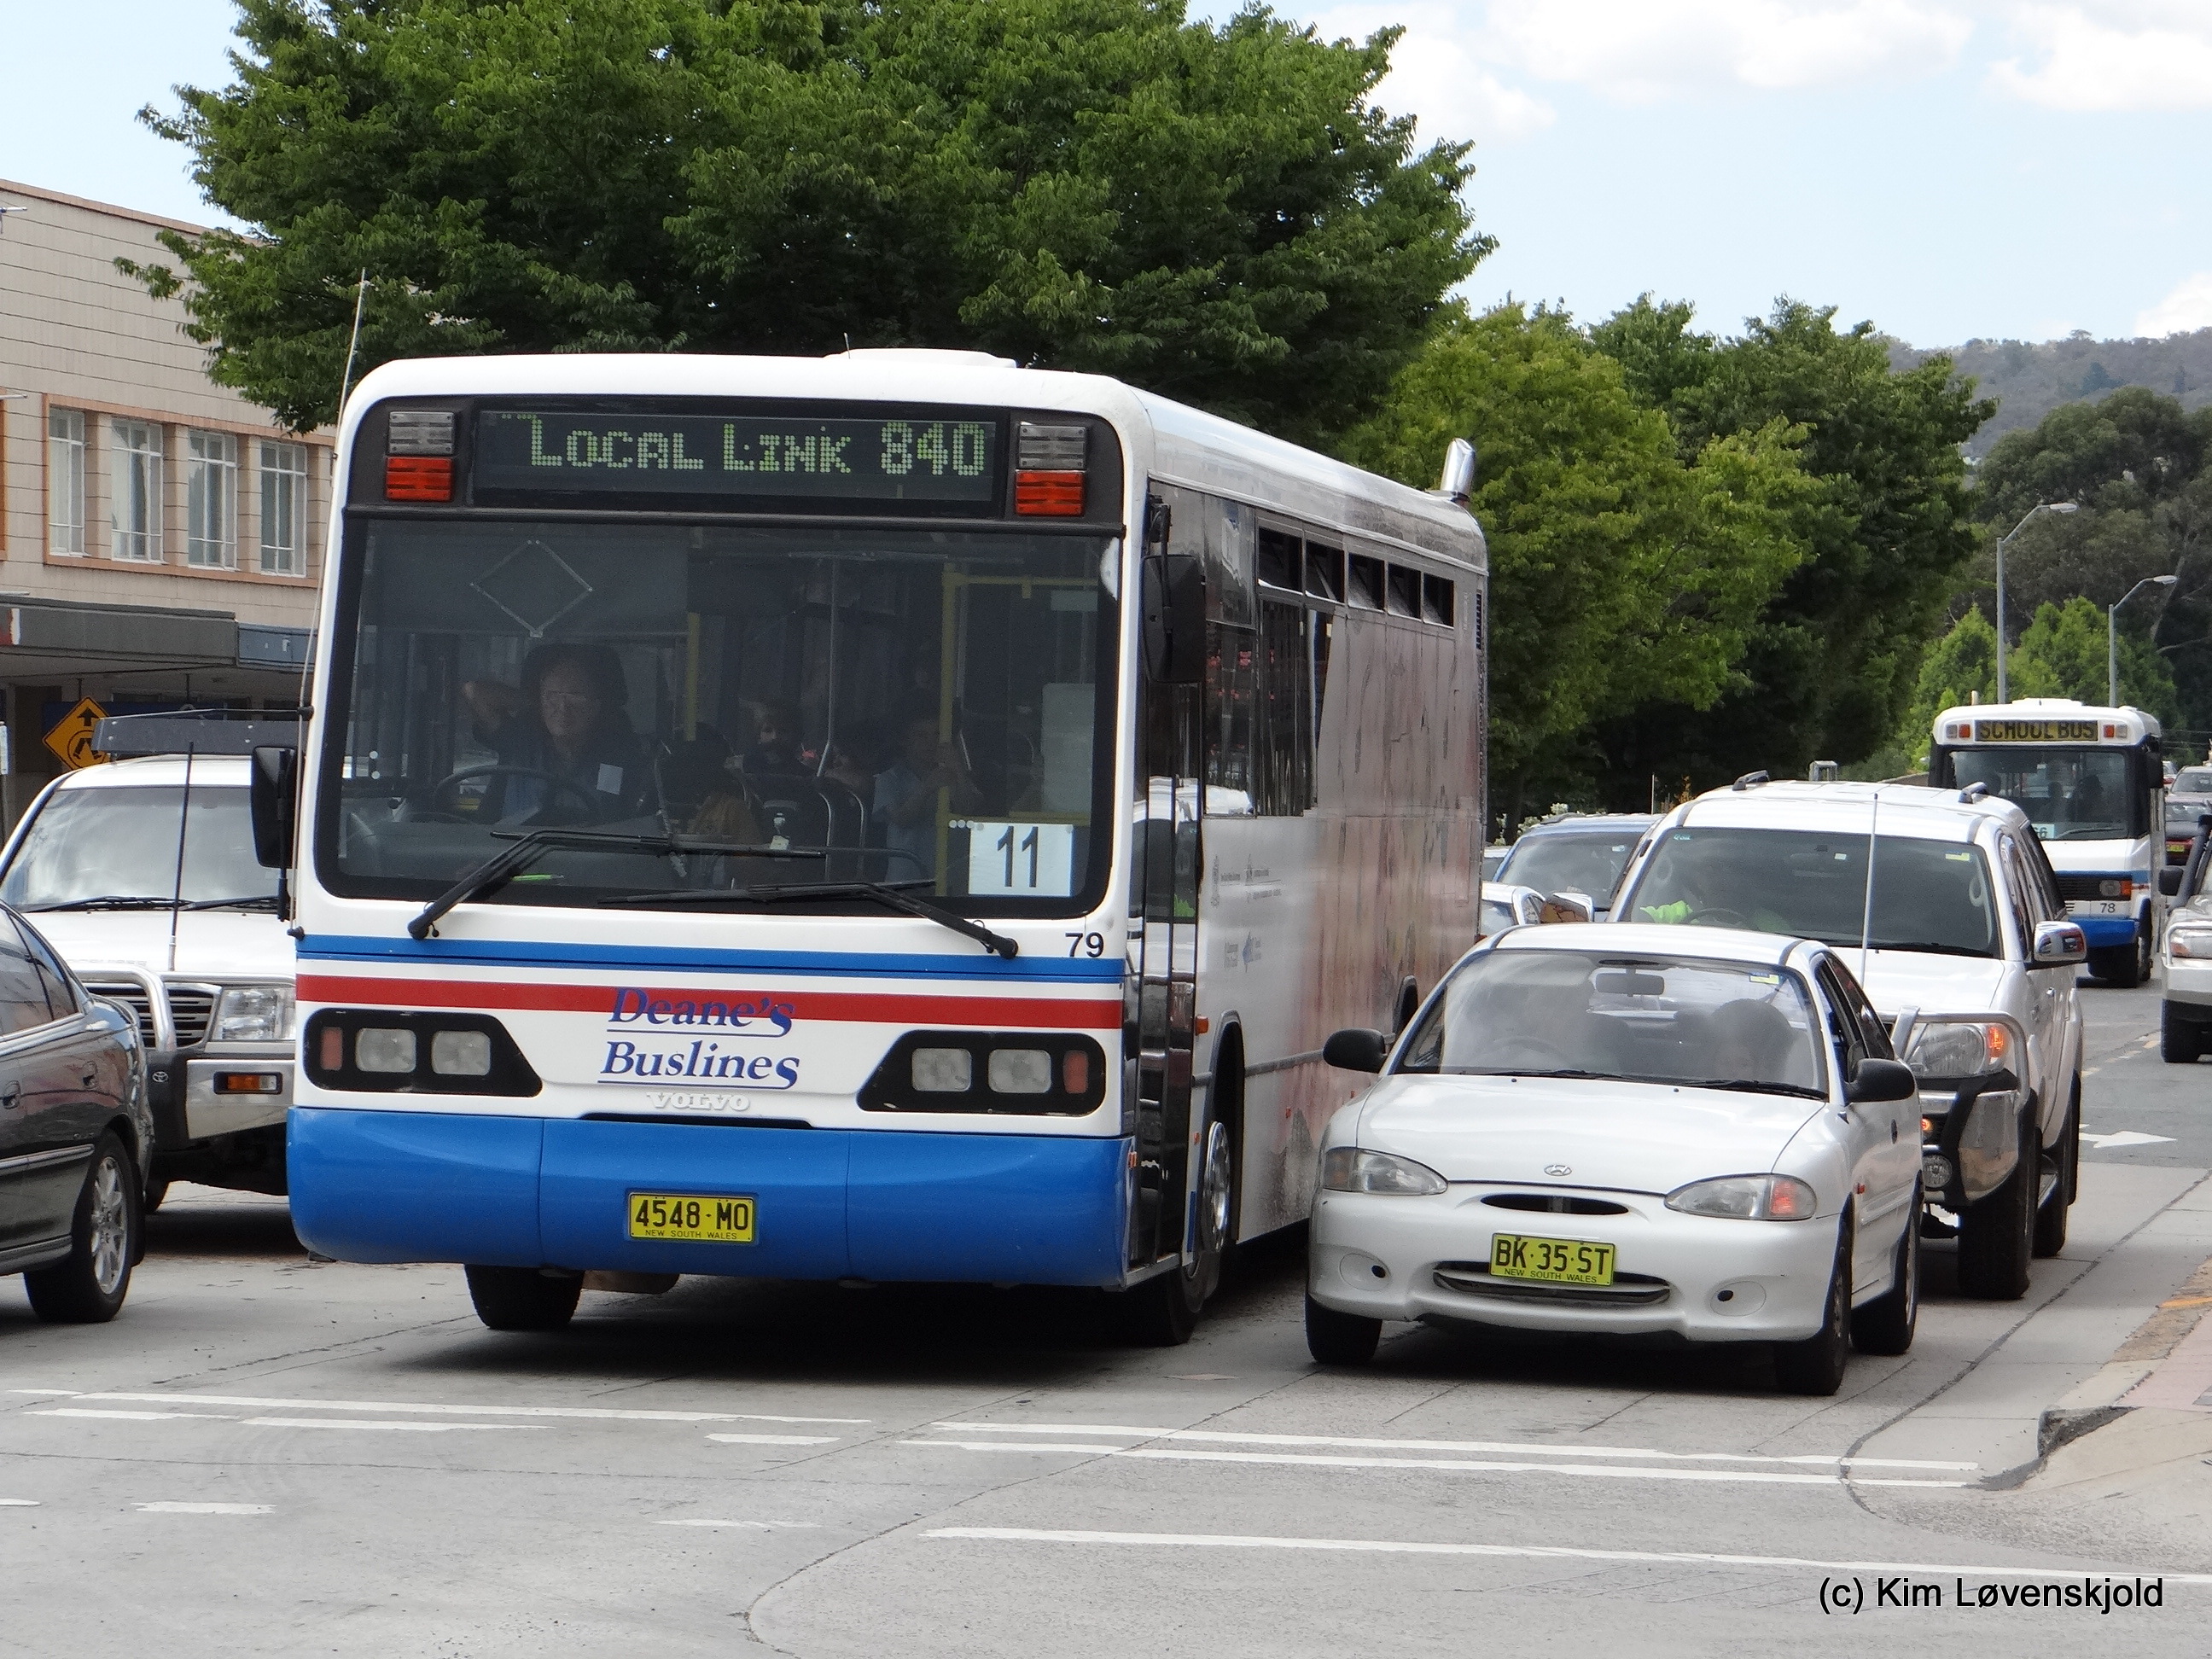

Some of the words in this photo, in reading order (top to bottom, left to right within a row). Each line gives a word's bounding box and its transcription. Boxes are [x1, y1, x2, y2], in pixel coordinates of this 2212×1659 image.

[881, 422, 985, 476] 840
[1980, 721, 2053, 739] SCHOOL
[2058, 721, 2094, 739] BUS
[998, 825, 1039, 888] 11
[2099, 902, 2116, 913] 78
[1064, 932, 1104, 958] 79
[608, 987, 795, 1038] Deane's
[598, 1040, 800, 1090] Buslines
[647, 1091, 750, 1111] VOLVO
[671, 1230, 701, 1238] SOUTH
[707, 1231, 737, 1240] WALES
[1530, 1271, 1561, 1280] SOUTH
[1567, 1274, 1597, 1284] WALES
